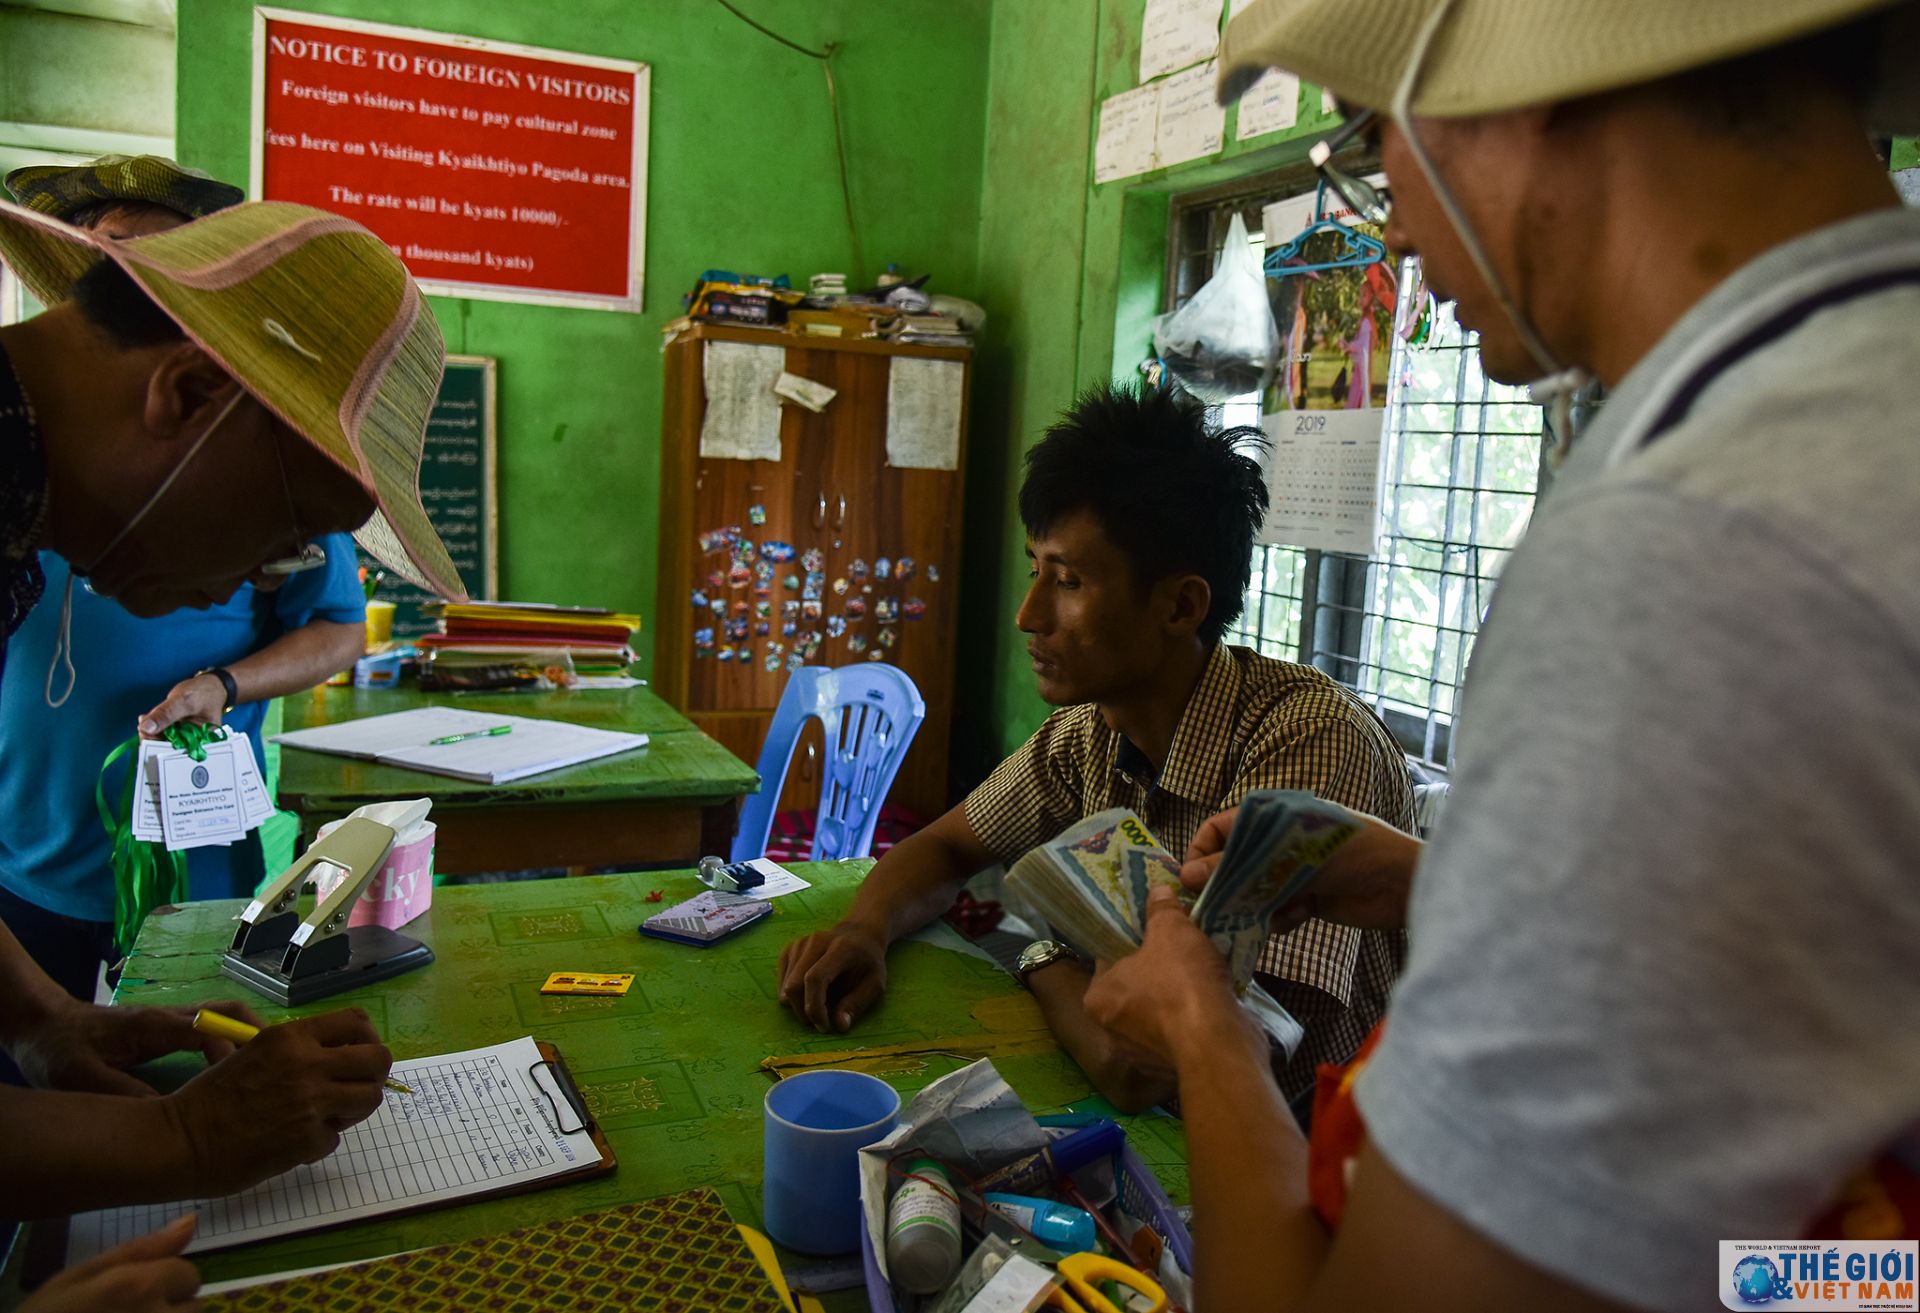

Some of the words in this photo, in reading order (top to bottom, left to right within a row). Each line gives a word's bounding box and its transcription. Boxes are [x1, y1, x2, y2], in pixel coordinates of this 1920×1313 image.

[269, 35, 367, 67] NOTICE
[372, 50, 408, 73] TO
[413, 55, 521, 88] FOREIGN
[526, 72, 631, 105] VISITORS
[281, 79, 349, 106] Foreign
[353, 90, 415, 113] visitors
[419, 98, 458, 119] have
[462, 106, 479, 121] to
[482, 110, 511, 129] pay
[515, 114, 578, 135] cultural
[582, 124, 618, 141] zone
[301, 132, 340, 152] here
[343, 141, 365, 156] on
[369, 141, 434, 167] Visiting
[438, 150, 528, 177] Kyaikhtiyo
[532, 161, 589, 183] Pagoda
[592, 173, 631, 189] area.
[329, 185, 363, 205] The
[367, 194, 401, 209] rate
[405, 196, 436, 213] will
[440, 198, 460, 215] be
[463, 201, 507, 221] kyats
[406, 244, 481, 265] thousand
[485, 251, 534, 271] kyats)
[1295, 416, 1327, 432] 2019
